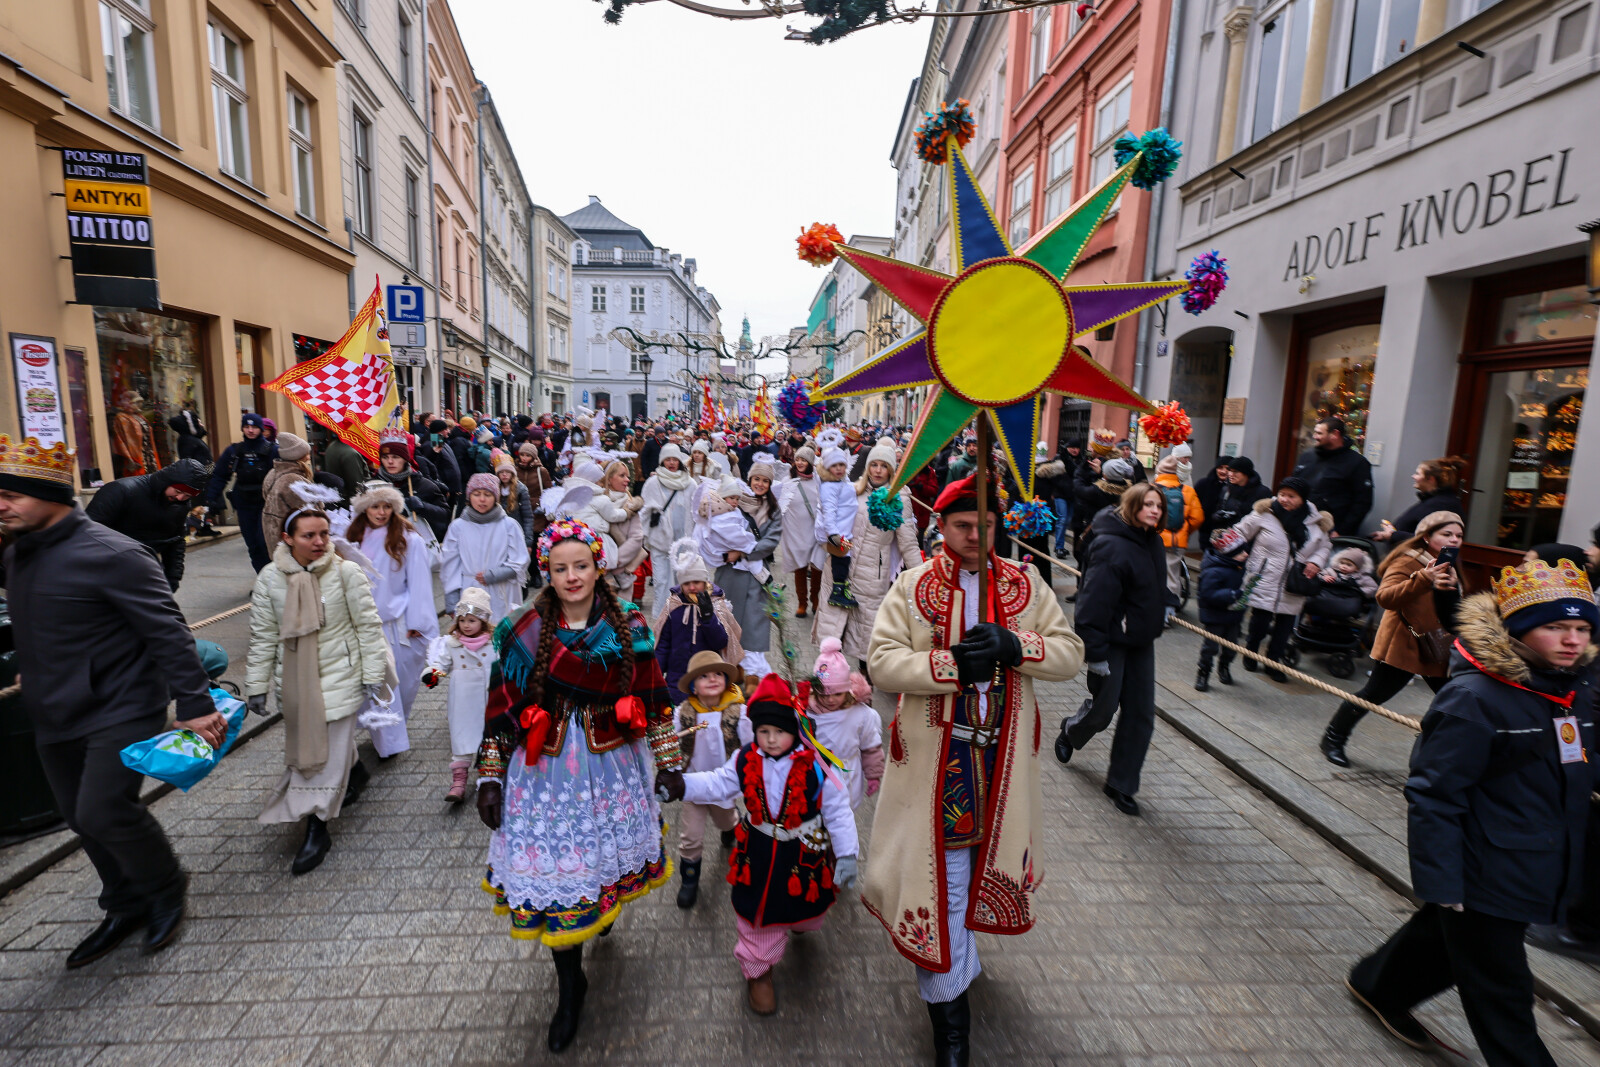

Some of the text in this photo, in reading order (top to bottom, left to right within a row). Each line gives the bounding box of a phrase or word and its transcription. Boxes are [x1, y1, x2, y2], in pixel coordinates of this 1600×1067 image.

[64, 150, 142, 167] POLSKI LEN
[66, 164, 106, 177] LINEN
[73, 188, 142, 208] ANTYKI
[1283, 147, 1580, 282] ADOLF KNOBEL
[67, 215, 150, 242] TATTOO
[394, 289, 417, 319] P
